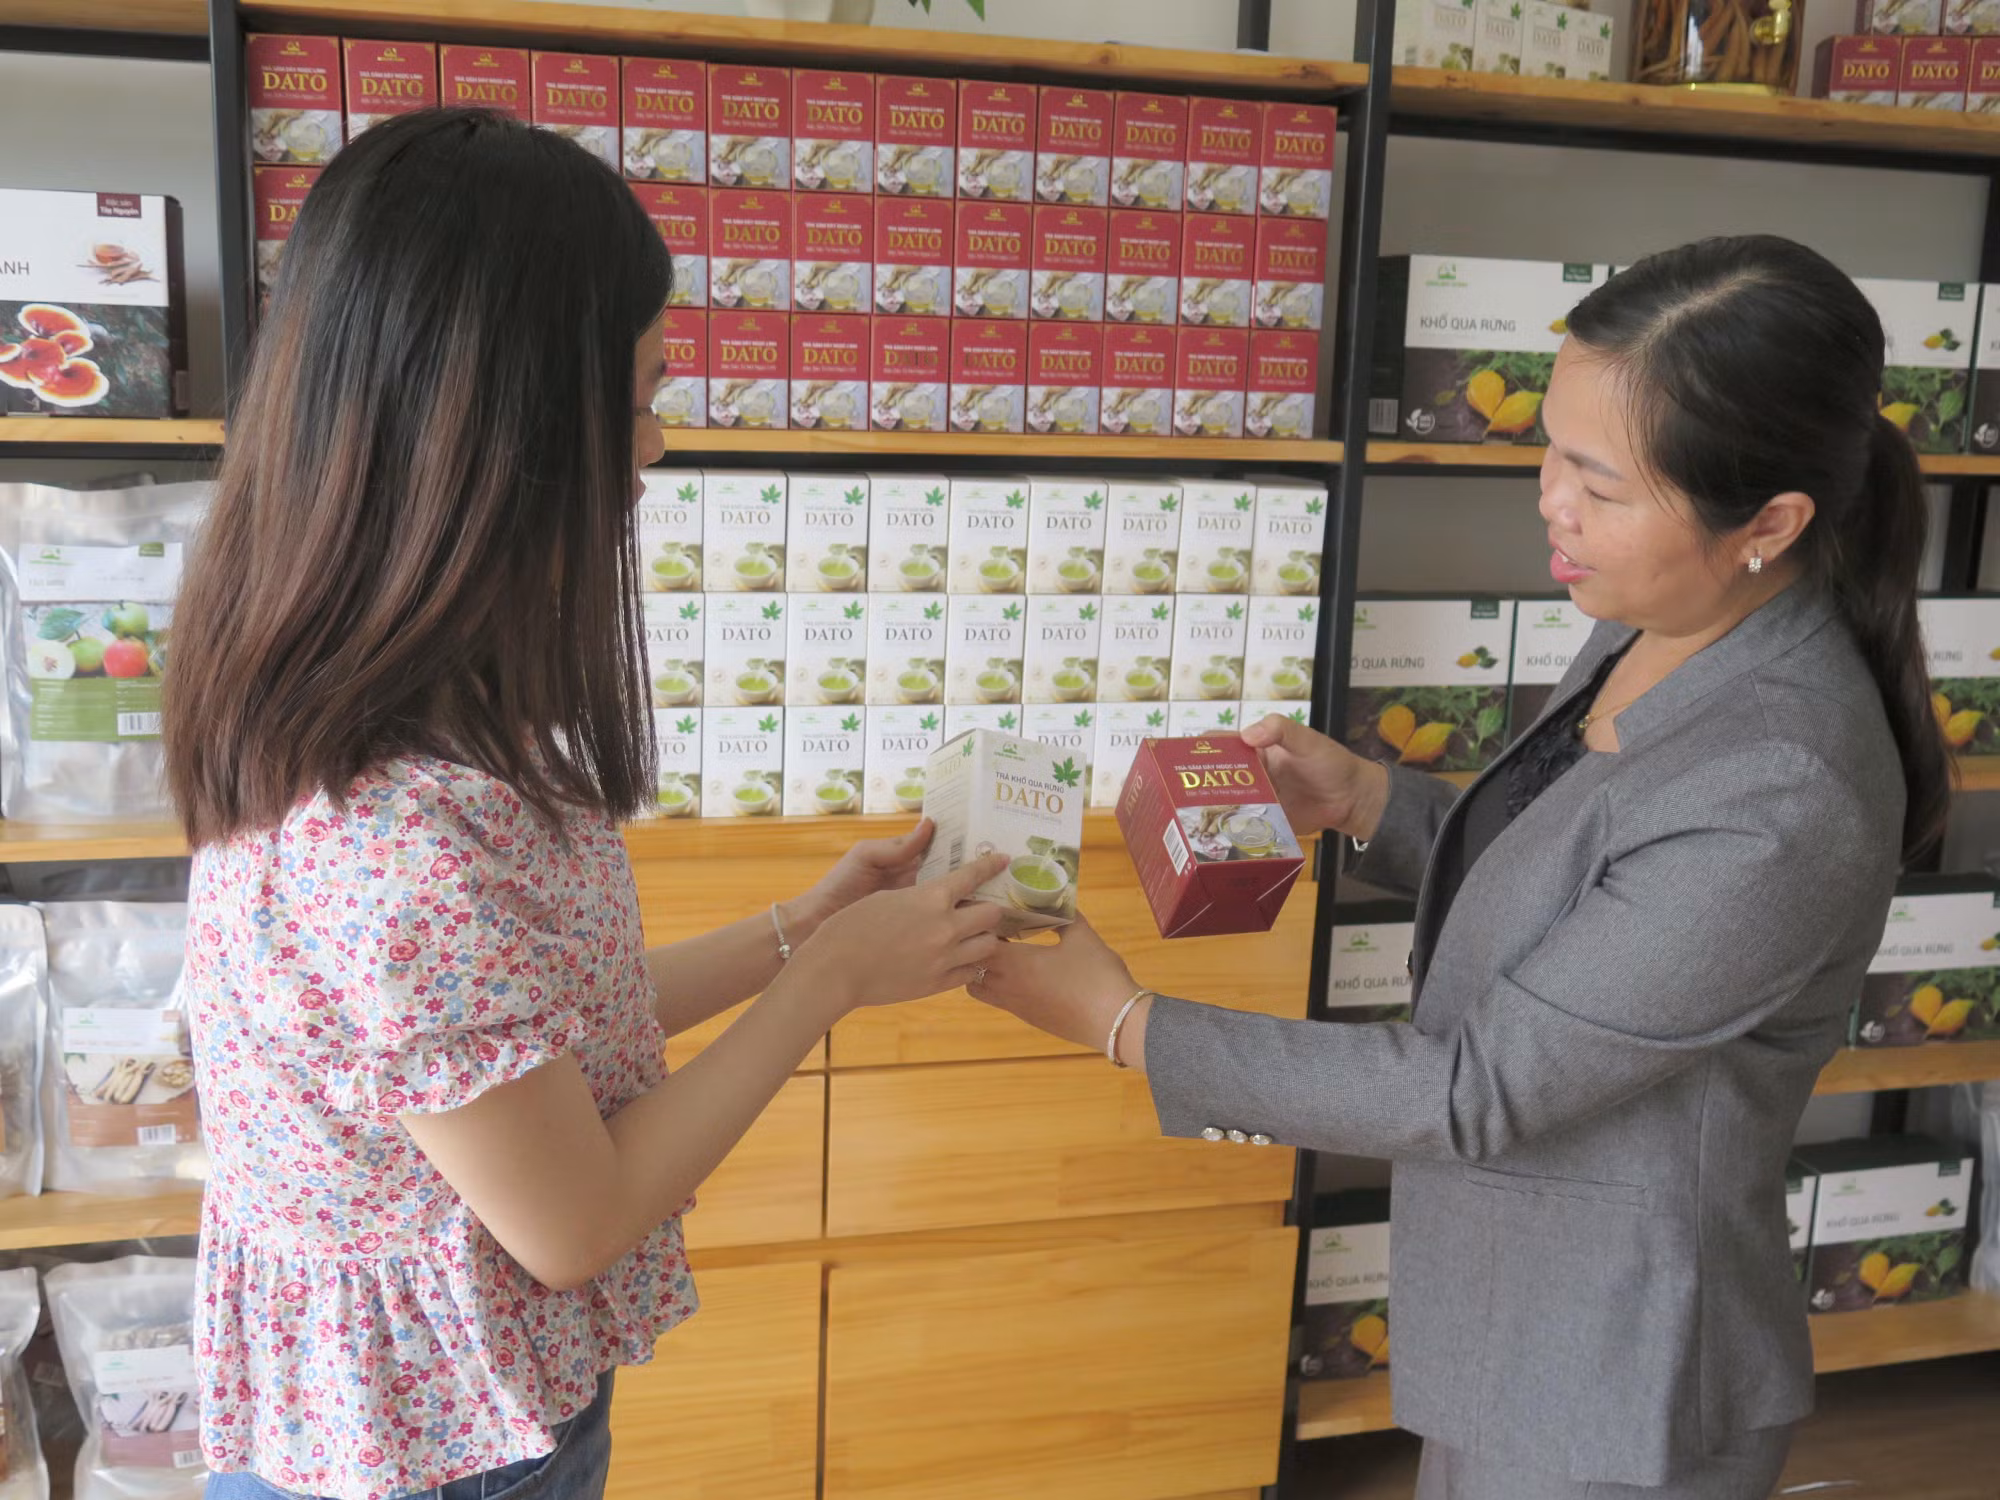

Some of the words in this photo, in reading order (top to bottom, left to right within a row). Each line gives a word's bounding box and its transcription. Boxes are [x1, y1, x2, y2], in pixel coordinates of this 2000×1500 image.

[1843, 63, 1890, 78] DATO
[1911, 63, 1959, 79] DATO
[263, 72, 328, 92] DATO
[360, 78, 424, 97] DATO
[456, 83, 518, 101] DATO
[547, 88, 607, 108] DATO
[635, 94, 694, 113] DATO
[722, 101, 780, 120] DATO
[808, 106, 863, 125] DATO
[890, 111, 945, 130] DATO
[972, 116, 1025, 135] DATO
[1050, 122, 1102, 140] DATO
[1127, 127, 1177, 145] DATO
[1202, 132, 1251, 150] DATO
[1275, 136, 1325, 155] DATO
[269, 205, 299, 222] DA
[657, 220, 697, 239] ATO
[724, 224, 780, 243] DATO
[807, 228, 863, 247] DATO
[888, 233, 942, 251] DATO
[968, 235, 1021, 253] DATO
[1045, 239, 1096, 256] DATO
[1120, 244, 1170, 261] DATO
[1195, 247, 1244, 264] DATO
[1269, 251, 1316, 268] DATO
[1451, 319, 1477, 331] QUA
[721, 345, 777, 363] DATO
[803, 348, 858, 365] DATO
[884, 349, 938, 367] DATO
[963, 352, 1016, 369] DATO
[1040, 354, 1091, 371] DATO
[1115, 356, 1165, 373] DATO
[1188, 358, 1237, 375] DATO
[1260, 361, 1308, 378] DATO
[721, 510, 771, 525] DATO
[805, 512, 854, 527] DATO
[887, 513, 935, 527] DATO
[967, 515, 1015, 529] DATO
[1046, 516, 1092, 530] DATO
[1123, 518, 1167, 532] DATO
[1197, 516, 1241, 531] DATO
[1268, 520, 1313, 534] DATO
[722, 628, 772, 642] DATO
[804, 628, 853, 642] DATO
[885, 627, 933, 641] DATO
[965, 628, 1011, 642] DATO
[1042, 627, 1087, 641] DATO
[1115, 626, 1159, 640] DATO
[1190, 625, 1233, 640] DATO
[1262, 627, 1305, 641] DATO
[1362, 657, 1387, 669] QUA
[1555, 657, 1571, 667] QU
[660, 741, 686, 755] TO
[718, 739, 768, 754] DATO
[802, 738, 850, 752] DATO
[881, 737, 929, 751] DATO
[1038, 735, 1082, 748] DATO
[1028, 779, 1043, 789] QUA
[1178, 769, 1255, 789] DATO
[995, 781, 1064, 815] DATO
[1364, 977, 1388, 989] QUA
